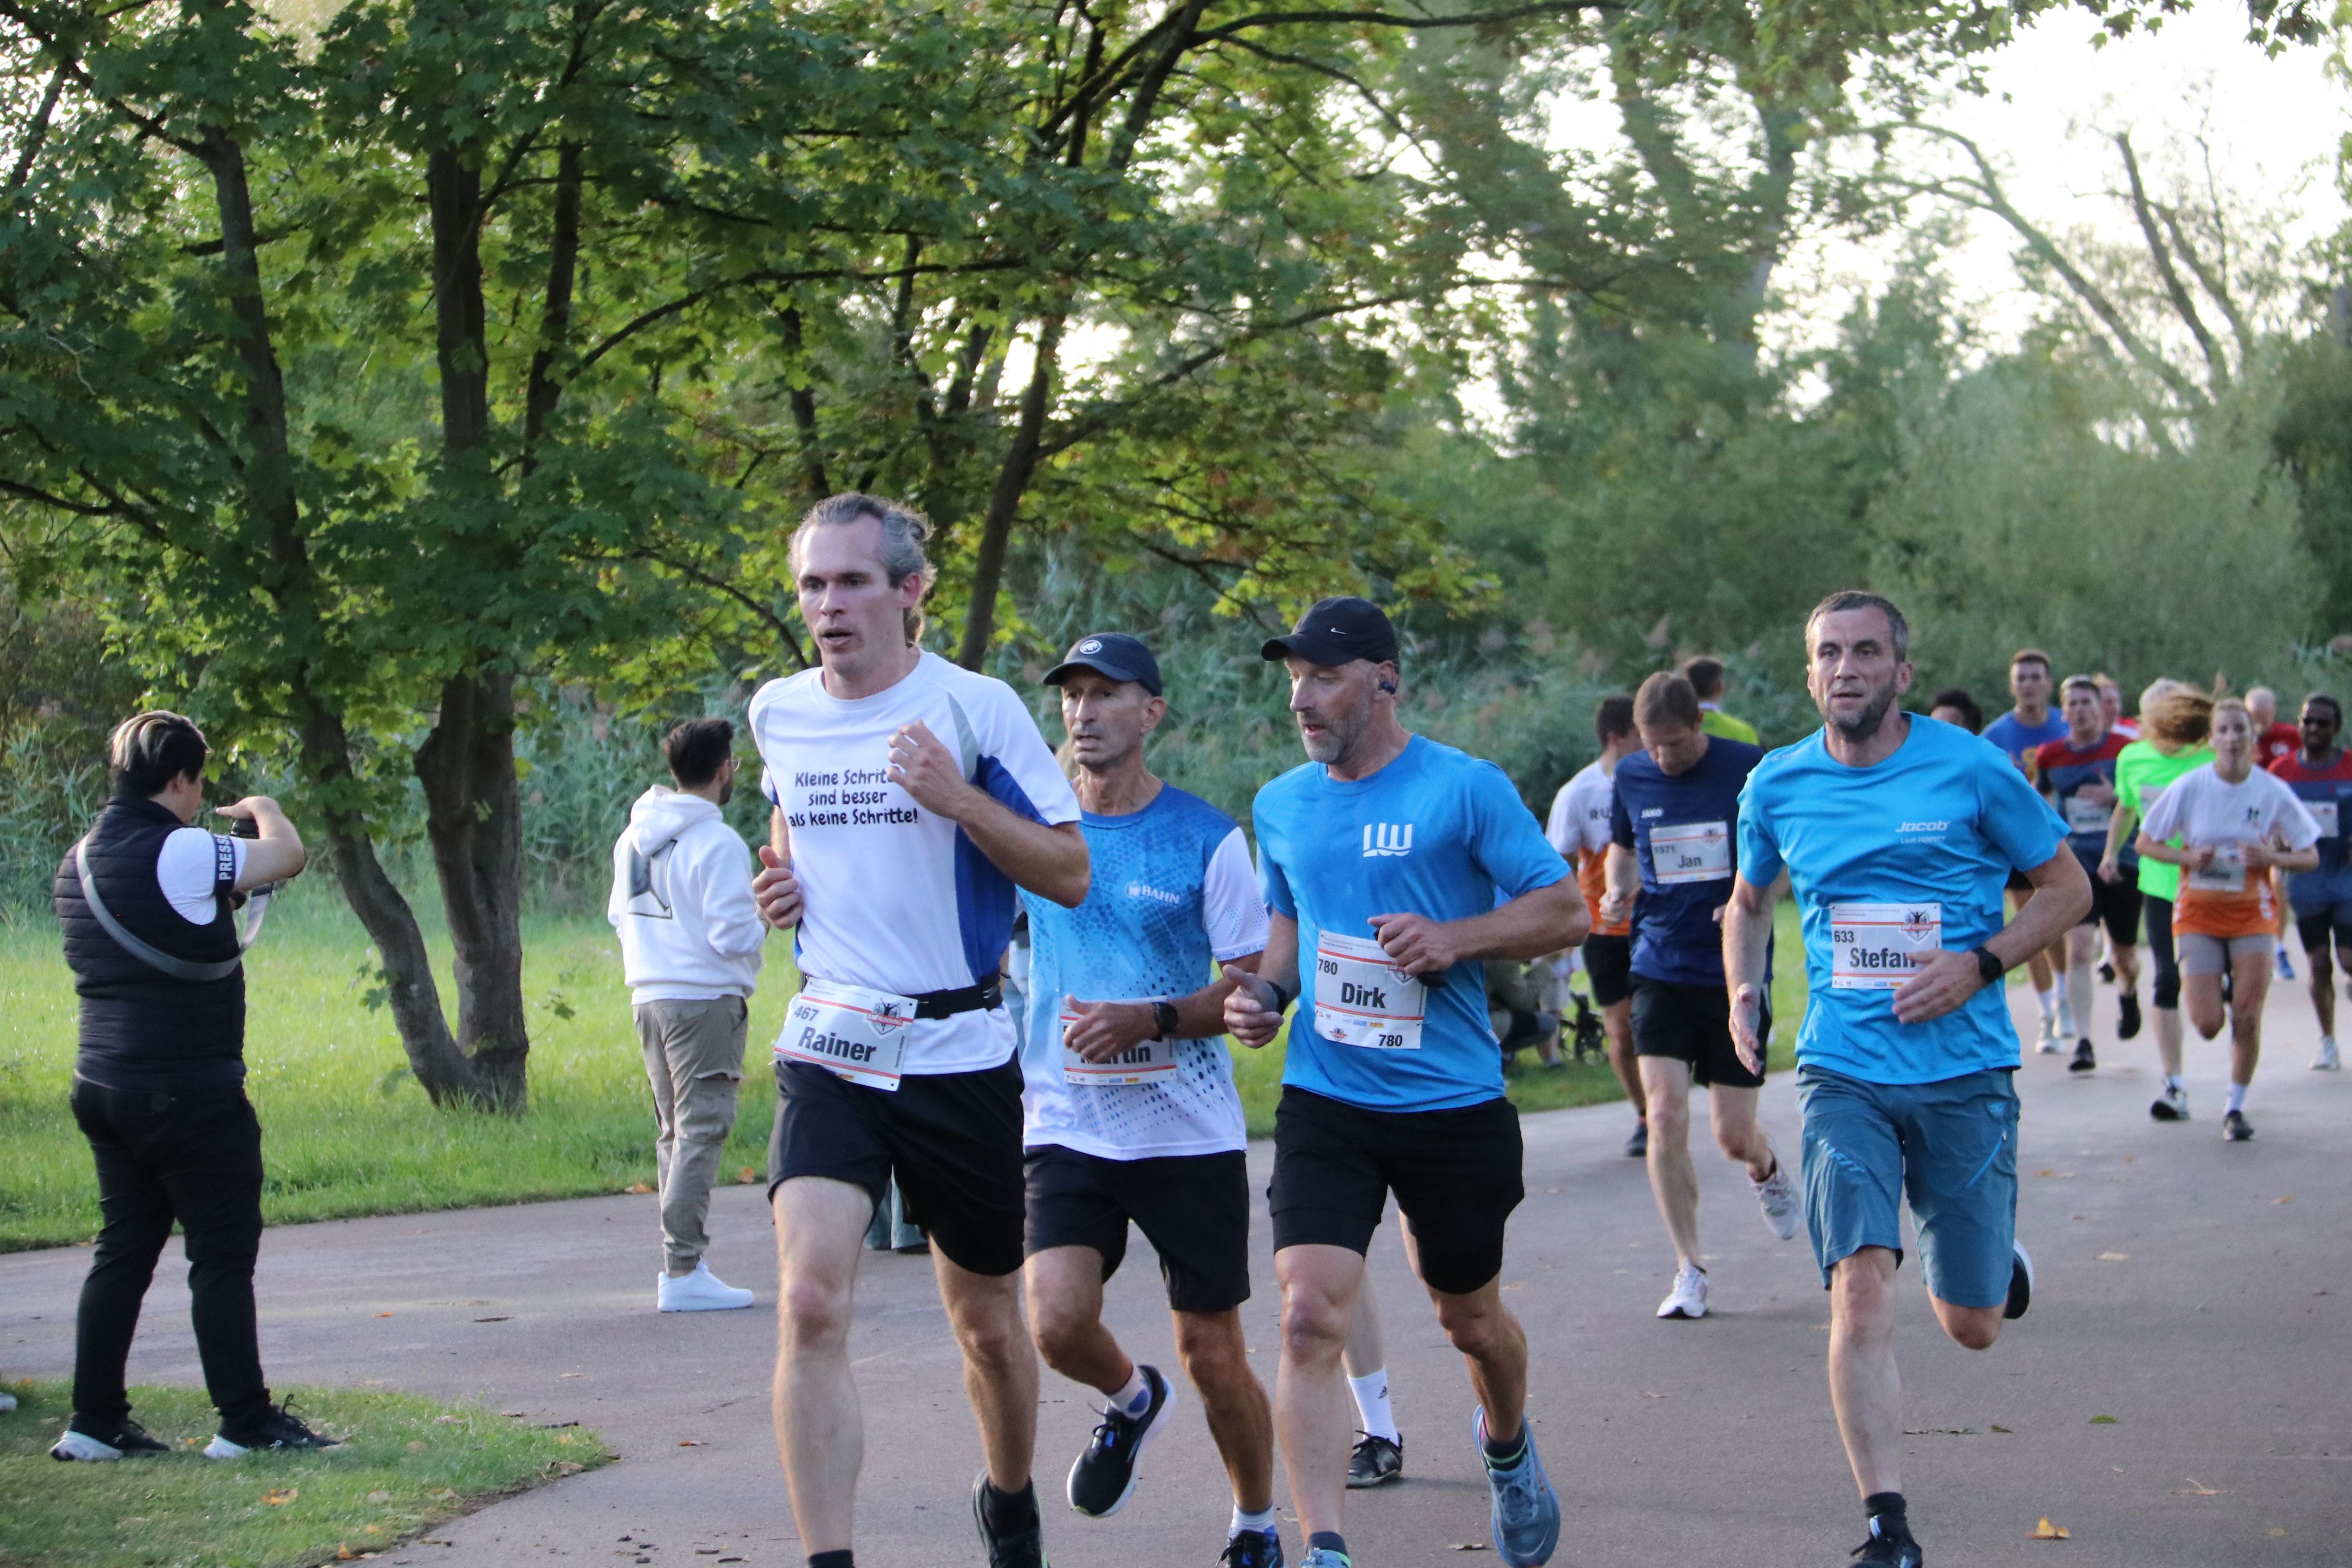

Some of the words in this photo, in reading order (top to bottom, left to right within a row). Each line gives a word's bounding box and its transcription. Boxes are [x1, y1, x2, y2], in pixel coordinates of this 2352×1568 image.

[795, 772, 838, 787] Kleine
[843, 769, 893, 785] Schrit
[808, 789, 837, 806] sind
[842, 789, 887, 805] besser
[788, 812, 805, 827] als
[809, 811, 848, 826] keine
[852, 808, 919, 825] Schritte!
[1895, 821, 1948, 832] Jacob
[1678, 855, 1702, 868] Jan
[1834, 930, 1854, 943] 633
[1318, 958, 1338, 975] 780
[1341, 982, 1387, 1009] Dirk
[794, 1005, 819, 1022] 467
[798, 1026, 877, 1063] Rainer
[1378, 1034, 1403, 1047] 780
